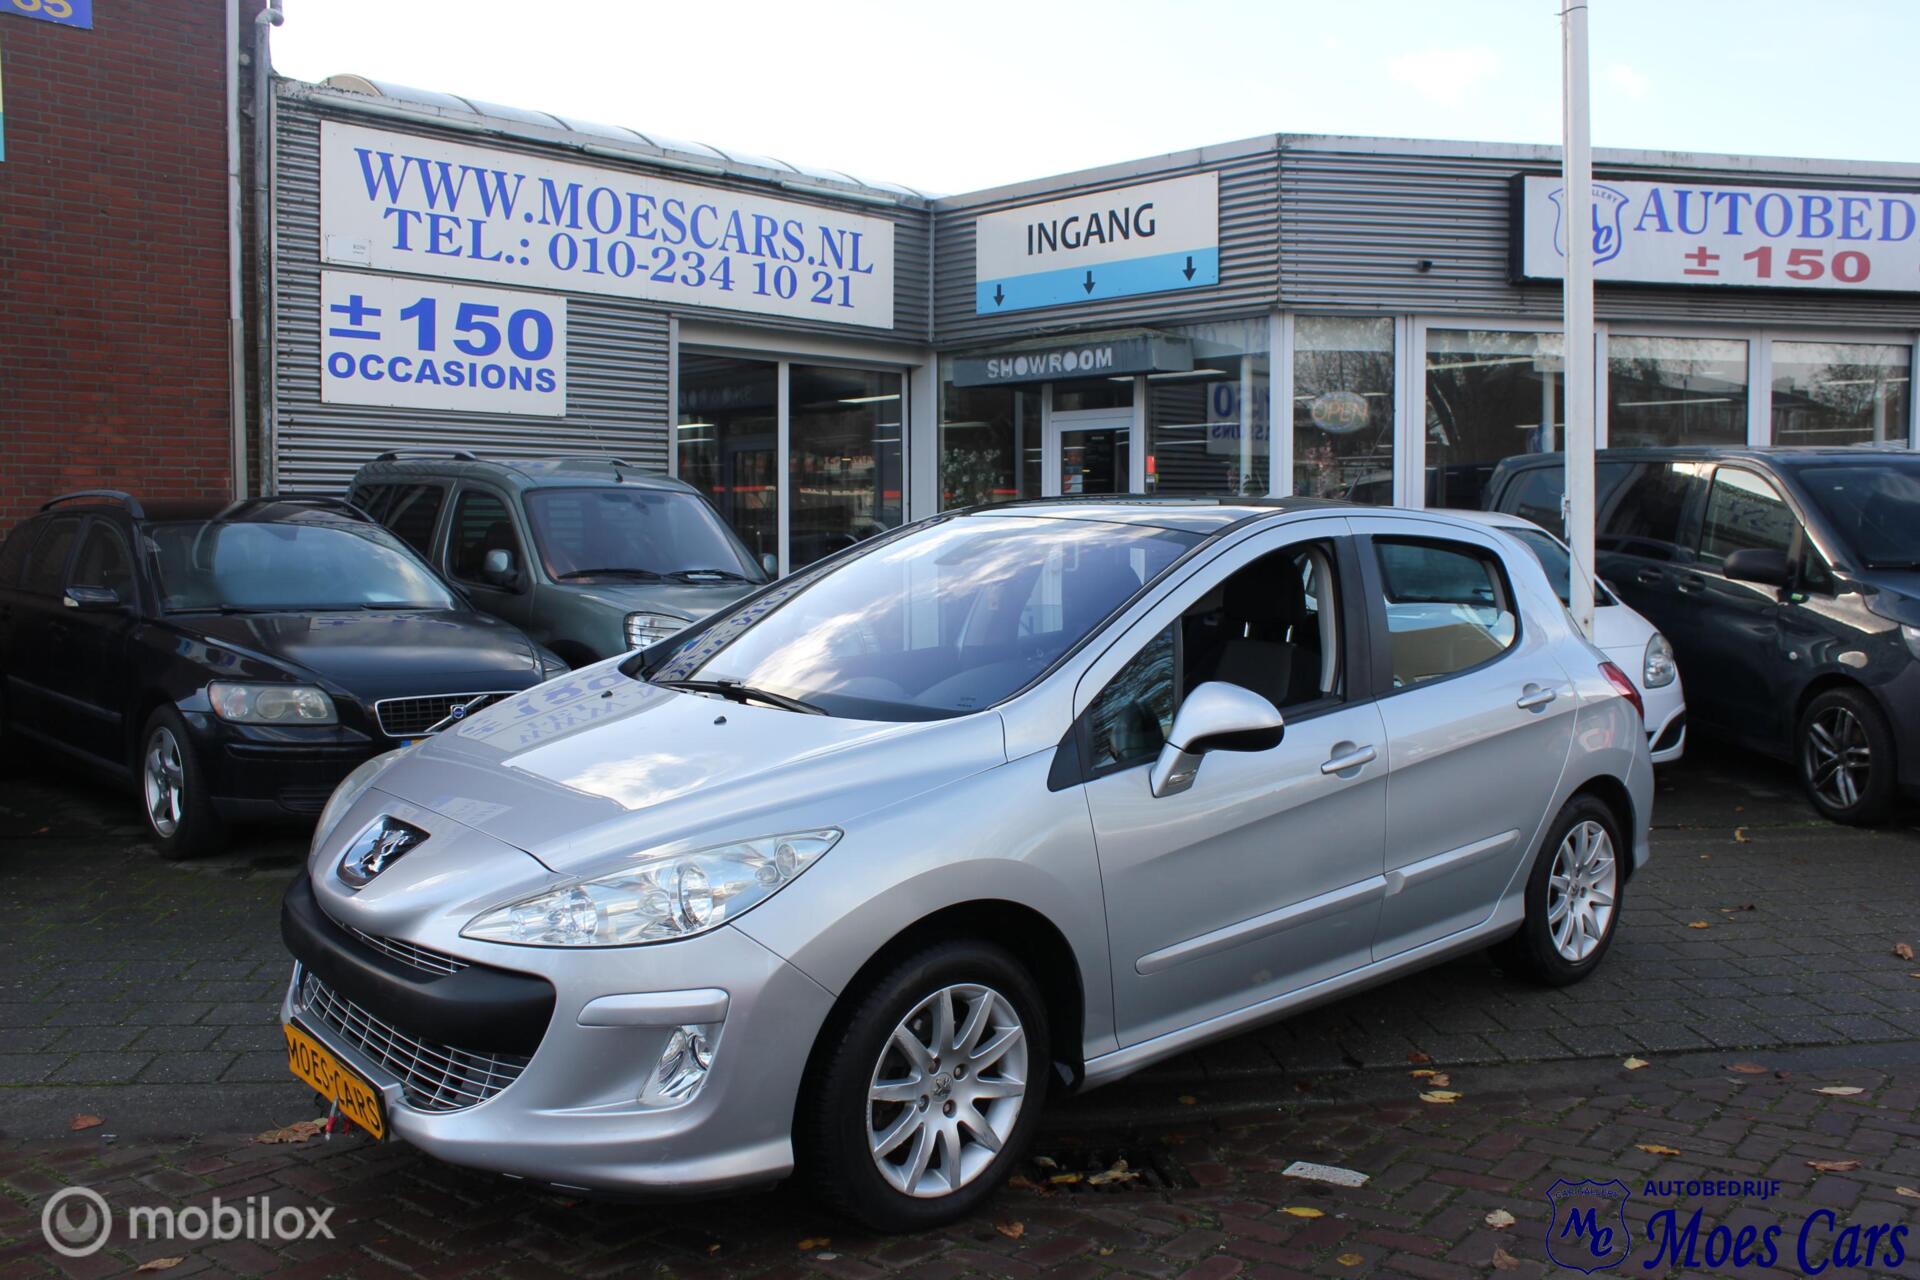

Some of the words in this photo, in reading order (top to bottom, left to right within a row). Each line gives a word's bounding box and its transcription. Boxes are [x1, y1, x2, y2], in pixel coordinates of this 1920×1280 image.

[354, 147, 874, 274] WWW.MOESCARS.NL
[1027, 203, 1156, 256] INGANG
[1634, 186, 1918, 242] AUTOBED
[383, 206, 529, 266] TEL.:
[547, 231, 736, 292] 010-234
[752, 260, 797, 300] 10
[810, 269, 855, 308] 21
[1743, 246, 1871, 283] 150
[326, 350, 557, 394] OCCASIONS
[987, 347, 1112, 378] SHOWROOM
